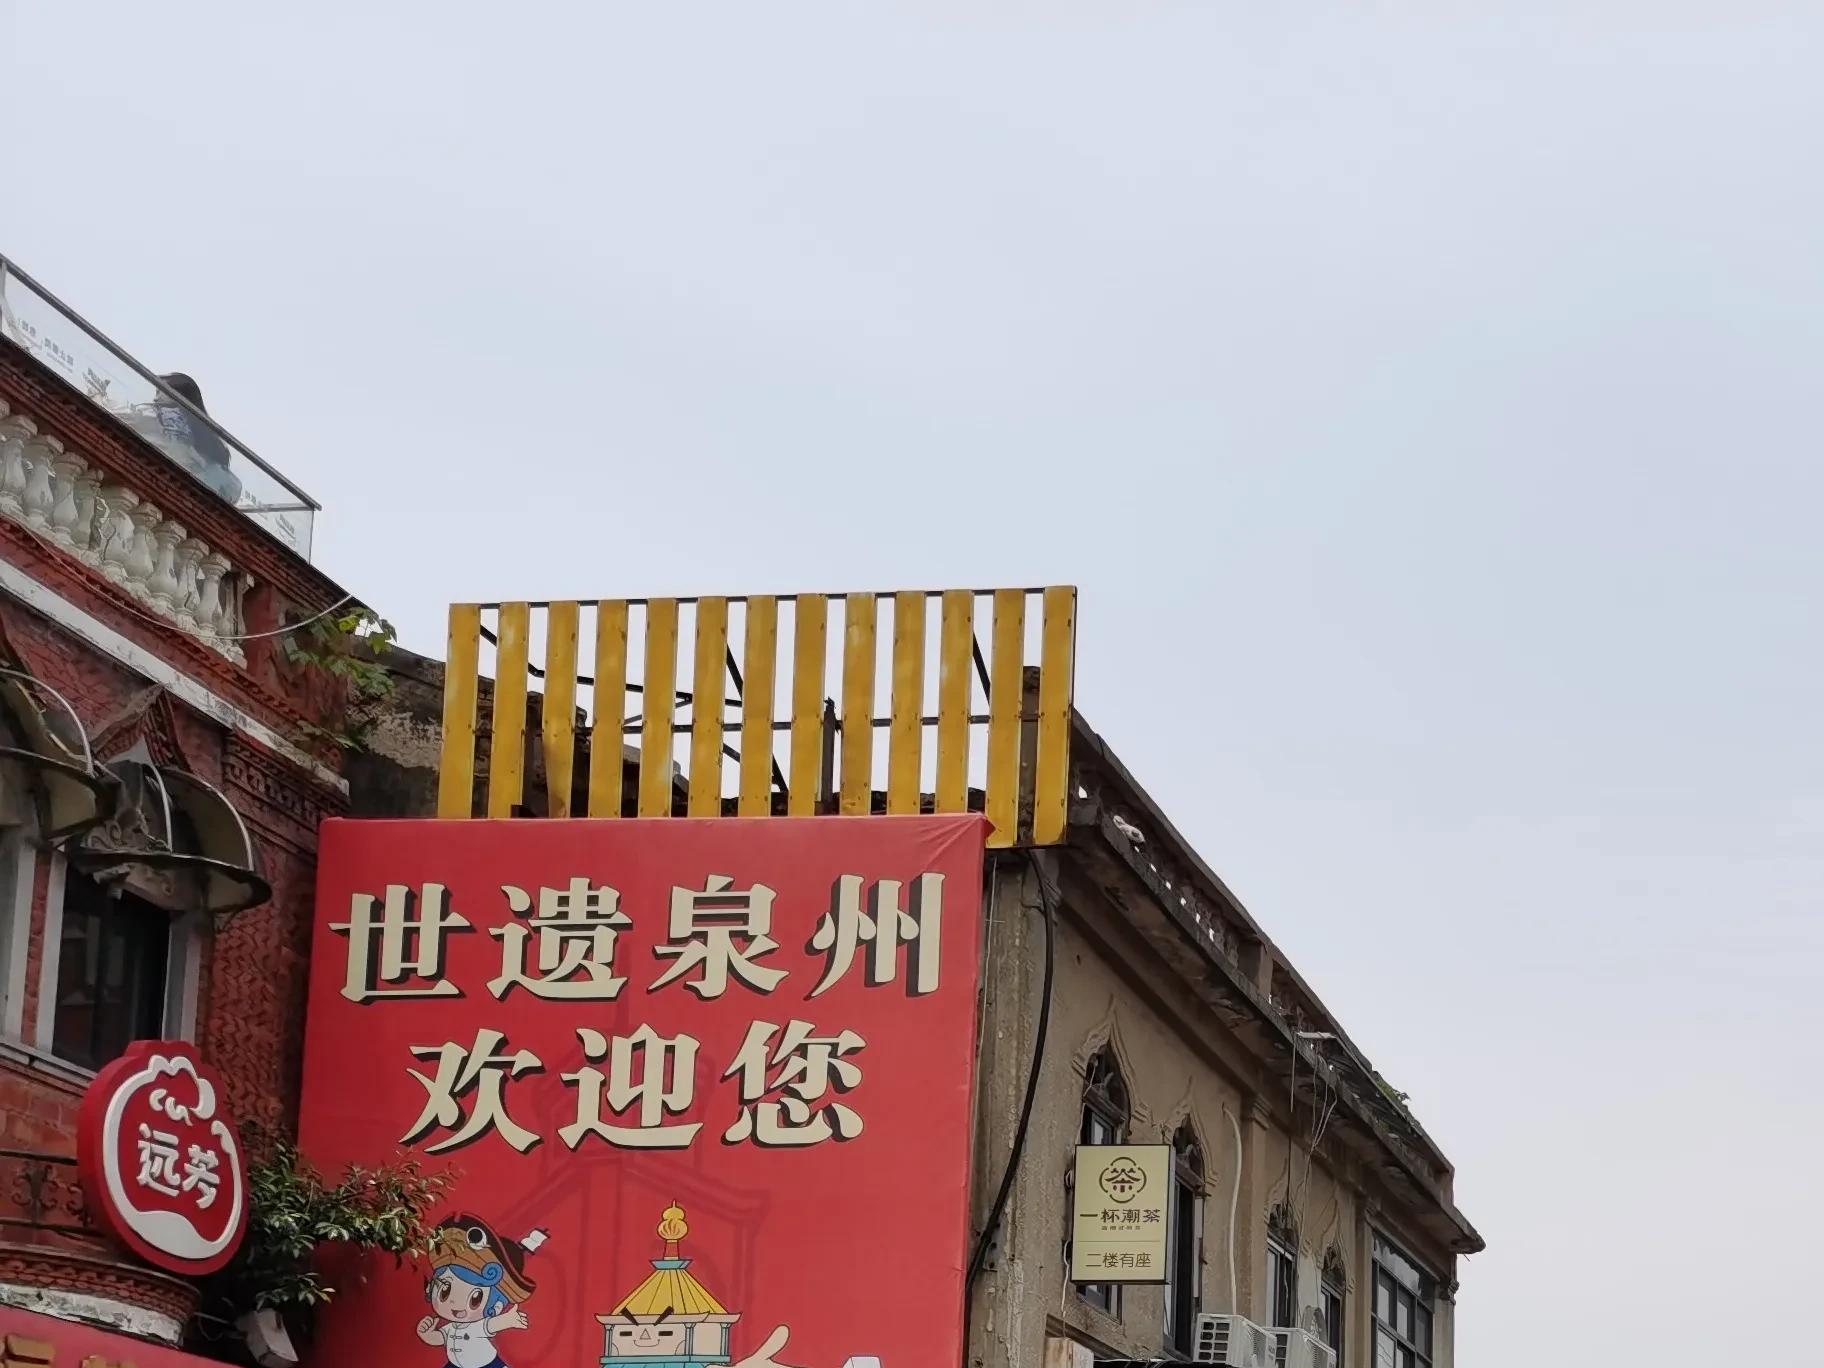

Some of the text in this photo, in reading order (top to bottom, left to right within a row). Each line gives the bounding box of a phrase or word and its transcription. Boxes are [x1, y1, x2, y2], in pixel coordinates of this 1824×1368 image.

[327, 873, 946, 1003] 世遗泉州
[399, 1018, 867, 1154] 欢迎您
[1079, 1207, 1161, 1224] 一杯潮茶
[1085, 1252, 1152, 1269] 二楼有座
